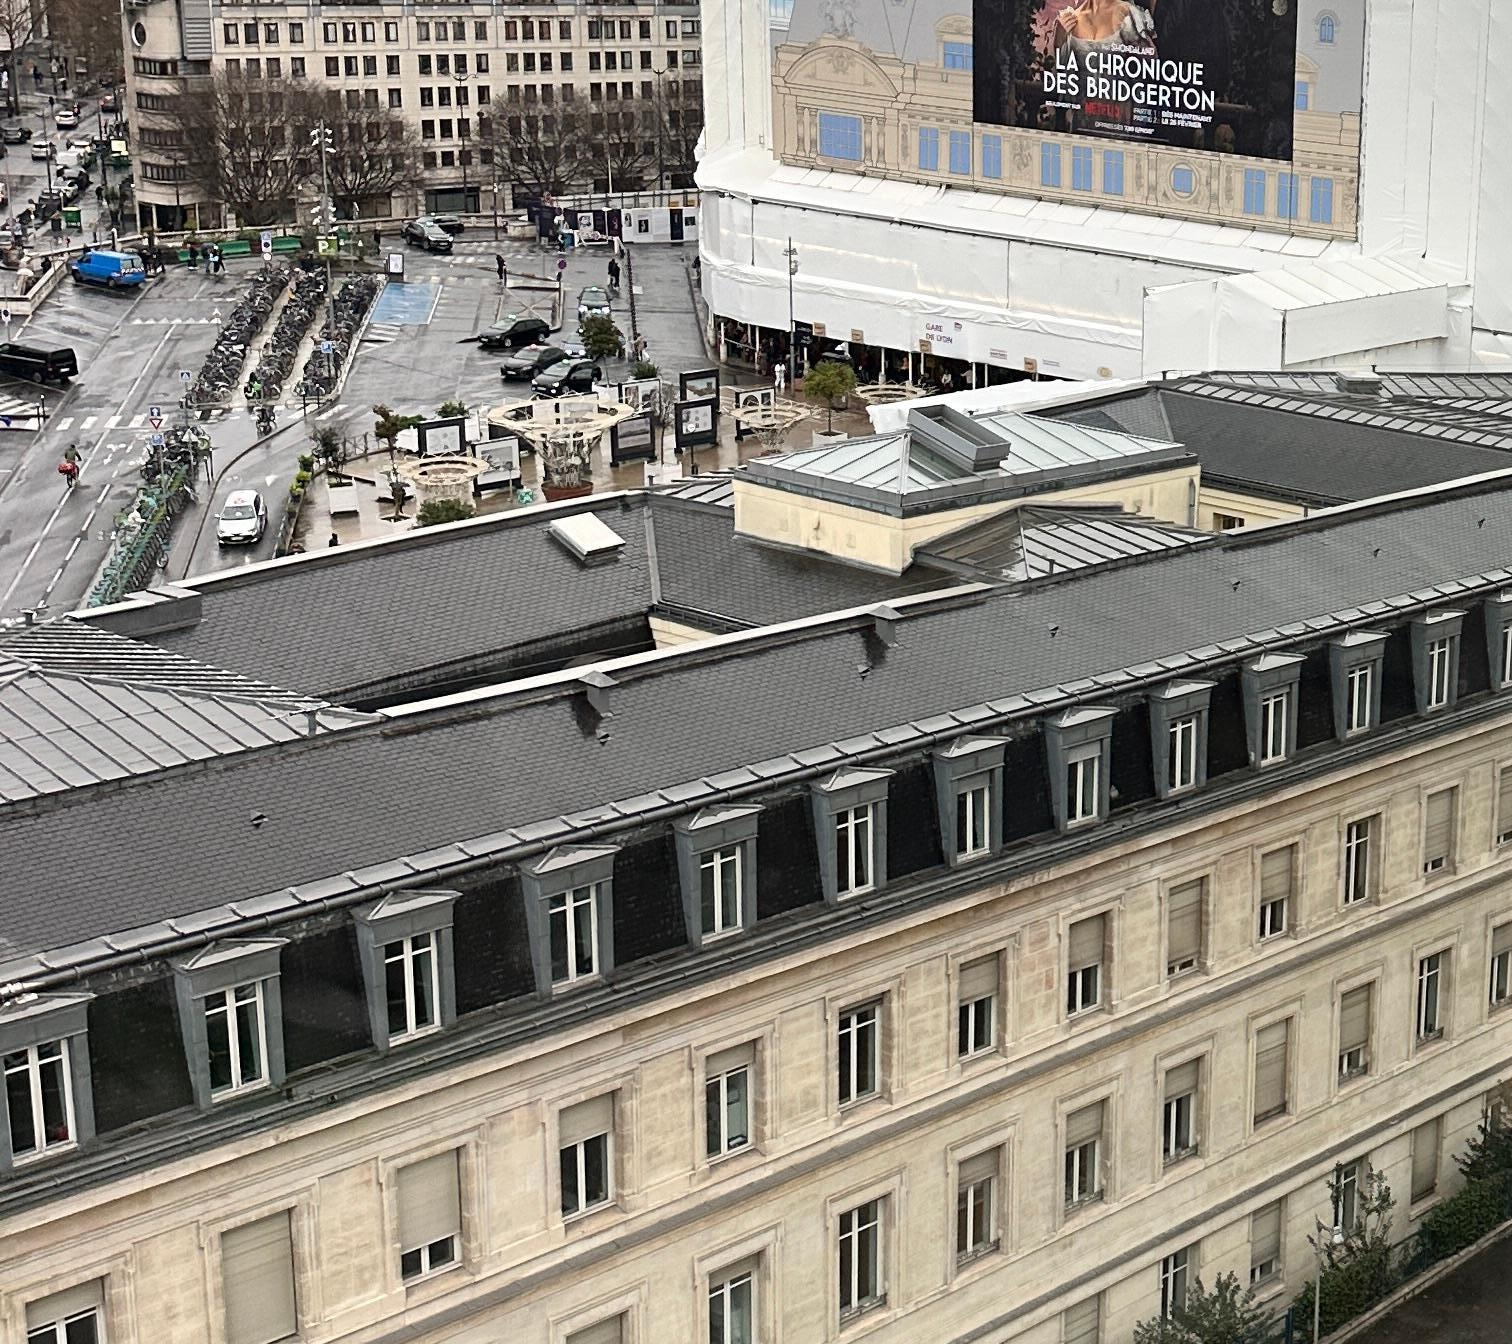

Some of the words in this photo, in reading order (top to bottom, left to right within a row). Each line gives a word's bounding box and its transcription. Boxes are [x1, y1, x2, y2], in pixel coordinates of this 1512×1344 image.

[1055, 47, 1079, 72] LA
[1085, 51, 1204, 86] CHRONIQUE
[1043, 70, 1079, 96] DES
[1086, 76, 1215, 112] BRIDGERTON
[318, 240, 329, 253] P
[926, 323, 943, 333] GARE
